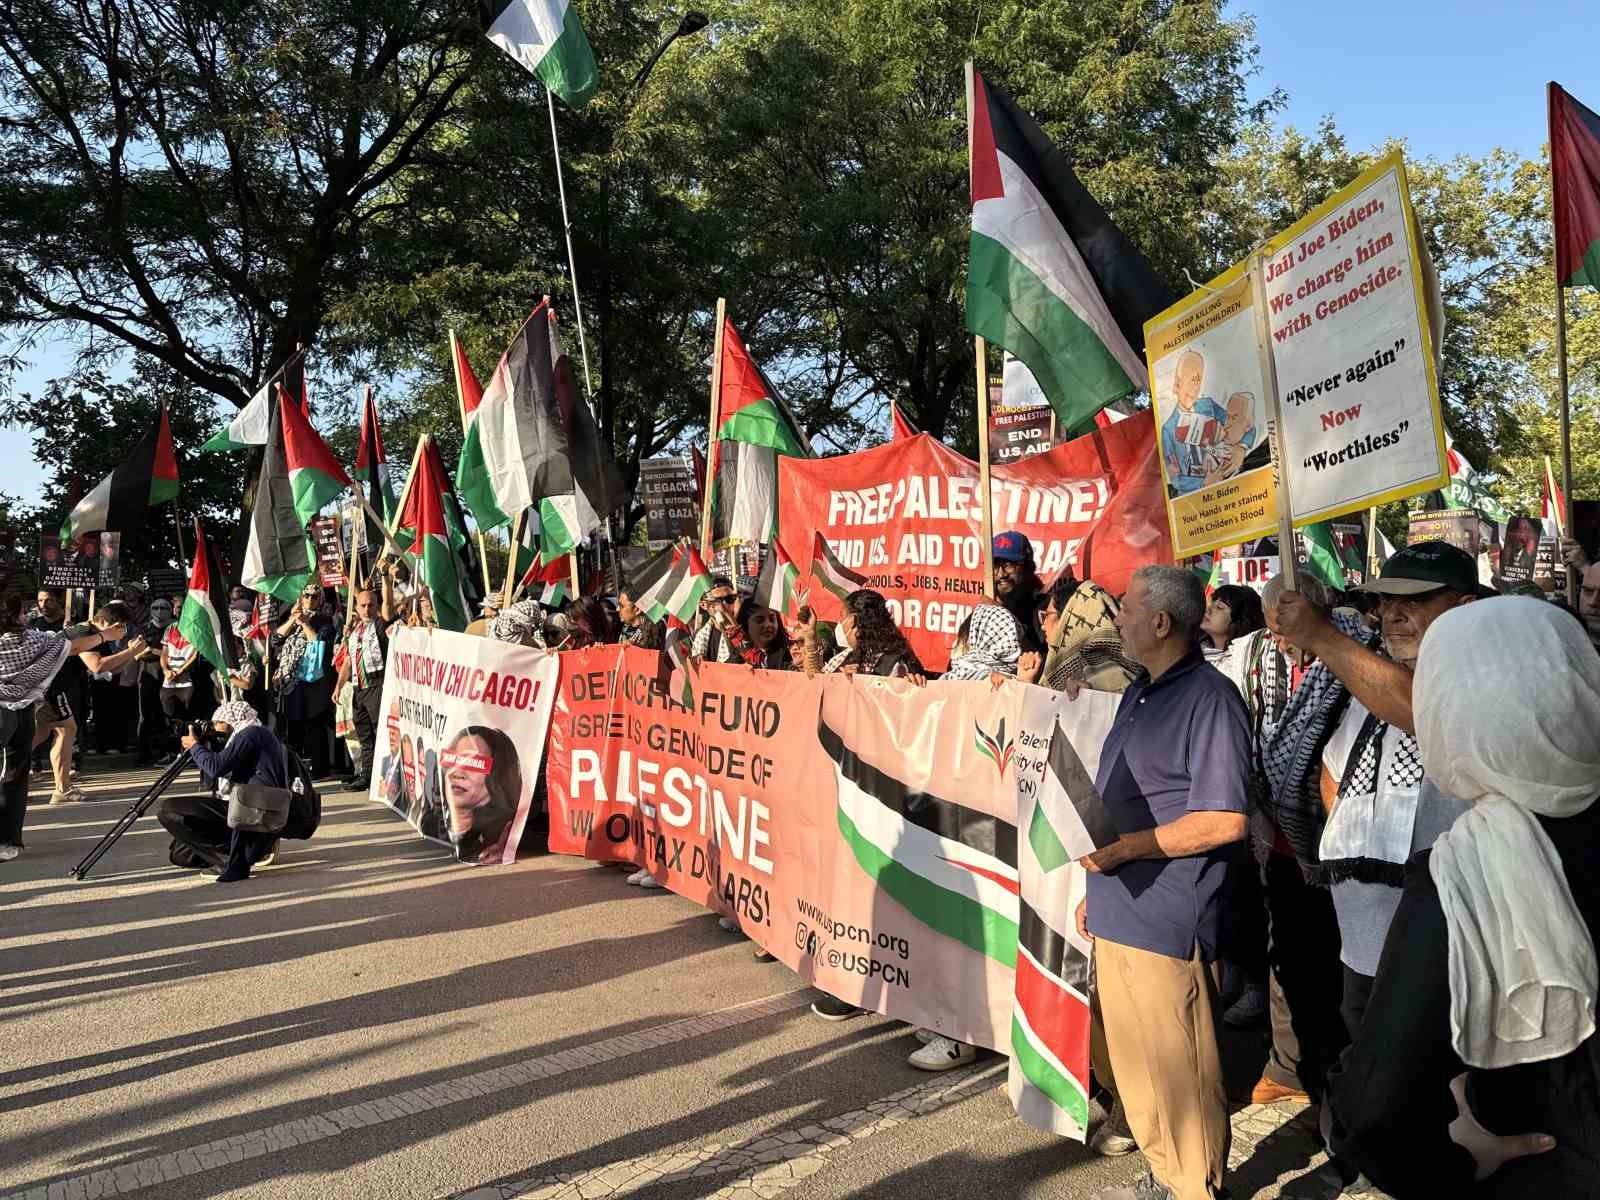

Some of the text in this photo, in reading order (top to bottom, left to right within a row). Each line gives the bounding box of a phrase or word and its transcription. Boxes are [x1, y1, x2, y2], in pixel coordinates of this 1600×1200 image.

[1266, 199, 1385, 283] Jail Joe Biden,
[1270, 232, 1394, 315] We charge him
[1177, 299, 1222, 331] STOP KILLING
[1273, 265, 1403, 344] with Genocide.
[1163, 300, 1241, 350] PALESTINIAN CHILDREN
[1286, 338, 1406, 407] “Never again”
[995, 415, 1013, 426] FREE
[1007, 428, 1042, 442] END
[1320, 403, 1362, 432] Now
[1025, 442, 1051, 455] AID
[1303, 420, 1409, 472] “Worthless”
[828, 482, 892, 526] FREE
[1182, 489, 1268, 524] Your Hands are stained
[1202, 485, 1239, 503] Mr. Biden
[649, 508, 693, 519] OF GAZA
[1188, 526, 1205, 537] with
[1240, 506, 1265, 521] Blood
[896, 533, 943, 567] AID
[950, 536, 980, 569] TO
[912, 575, 941, 592] JOBS,
[1236, 558, 1269, 583] JOE
[885, 599, 922, 628] OR
[400, 652, 412, 681] NOT
[434, 660, 448, 692] IN
[444, 663, 541, 712] CHICAGO!
[701, 691, 781, 739] FUND
[751, 752, 773, 788] OF
[646, 829, 687, 872] TAX
[797, 898, 909, 960] www.uspcn.org
[827, 949, 909, 988] @USPCN
